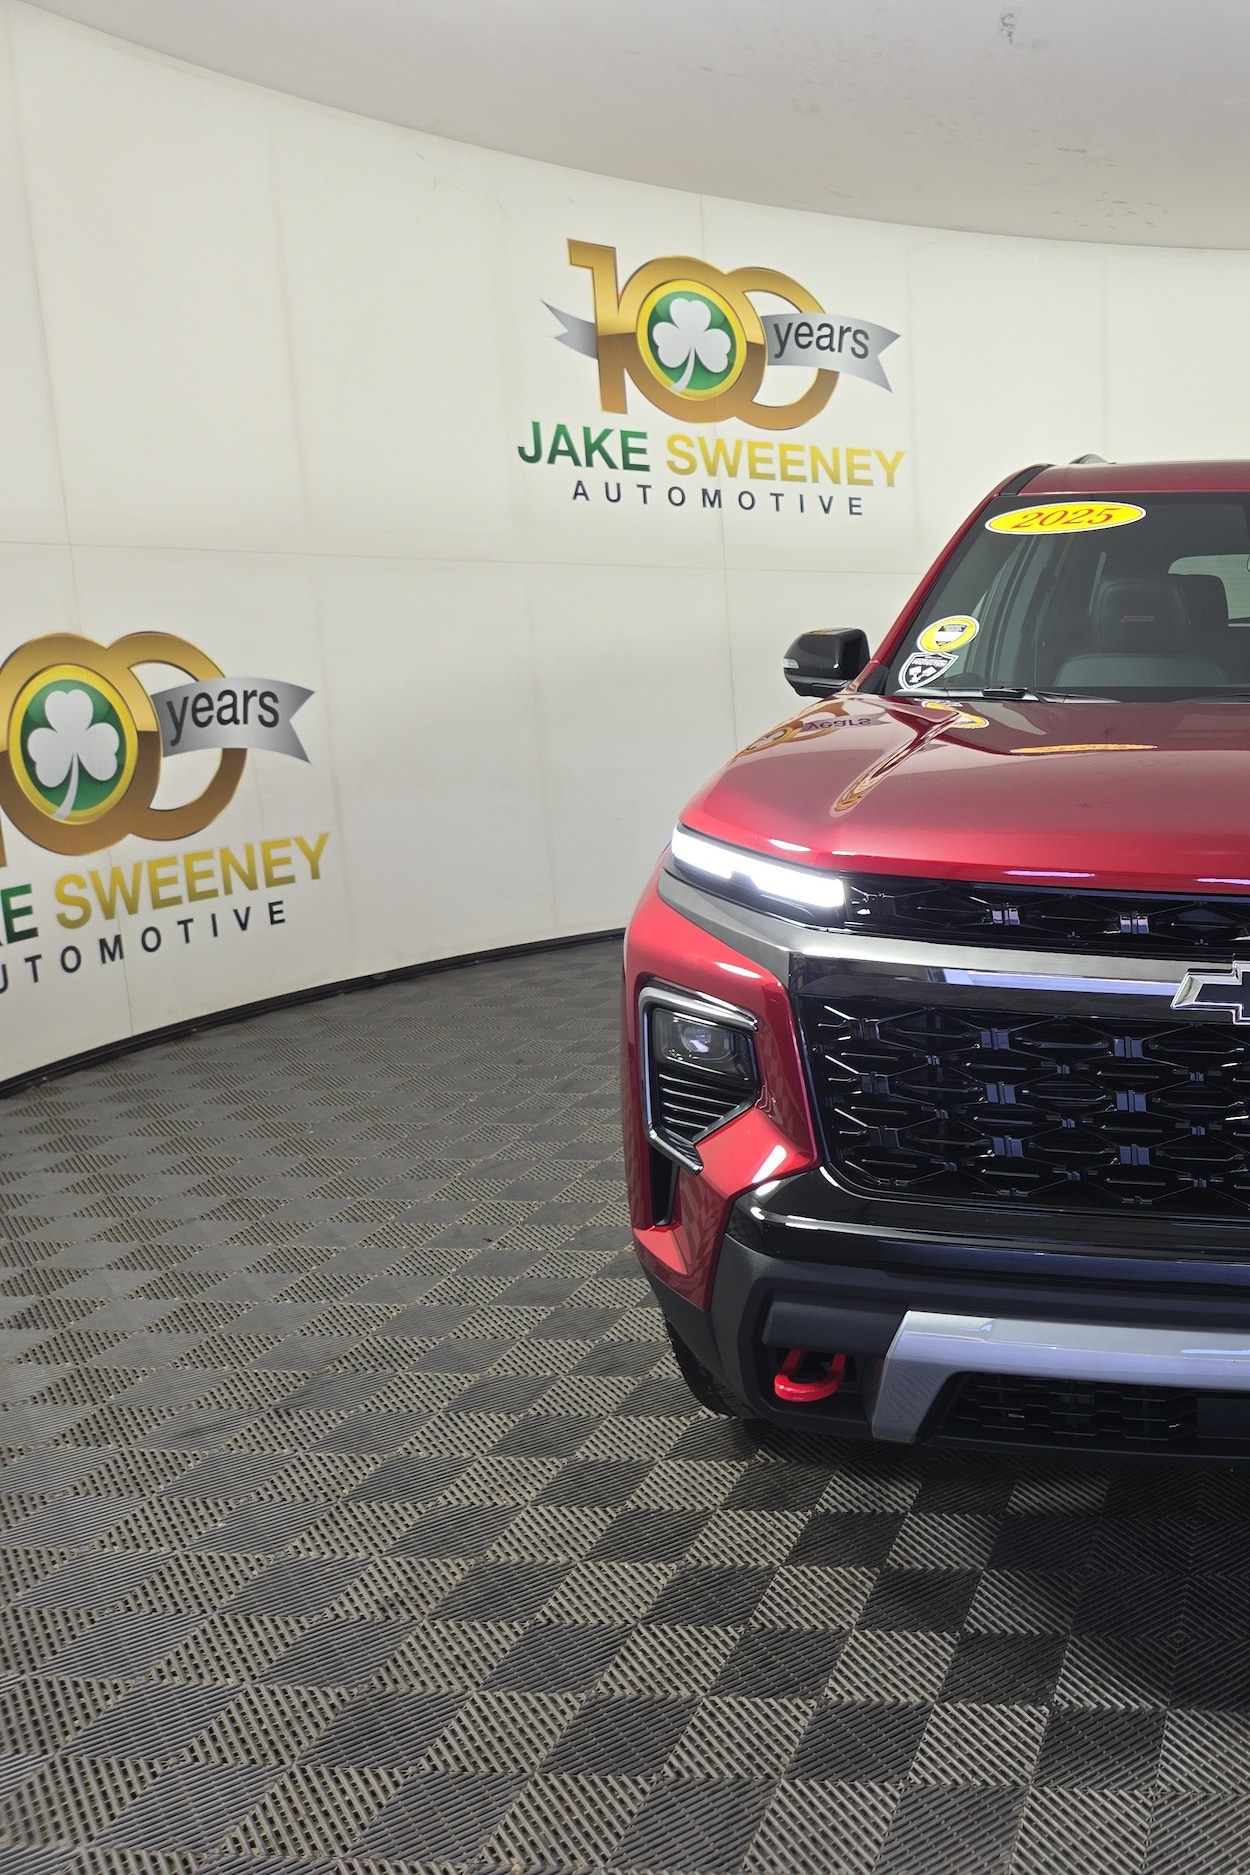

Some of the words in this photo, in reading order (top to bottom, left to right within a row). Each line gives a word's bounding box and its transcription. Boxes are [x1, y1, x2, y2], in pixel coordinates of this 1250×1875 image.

[773, 319, 870, 359] years
[517, 420, 651, 472] JAKE
[666, 434, 907, 488] SWEENEY
[572, 480, 864, 516] AUTOMOTIVE
[1012, 507, 1122, 529] 2025
[166, 688, 280, 747] years
[54, 833, 330, 930] SWEENEY
